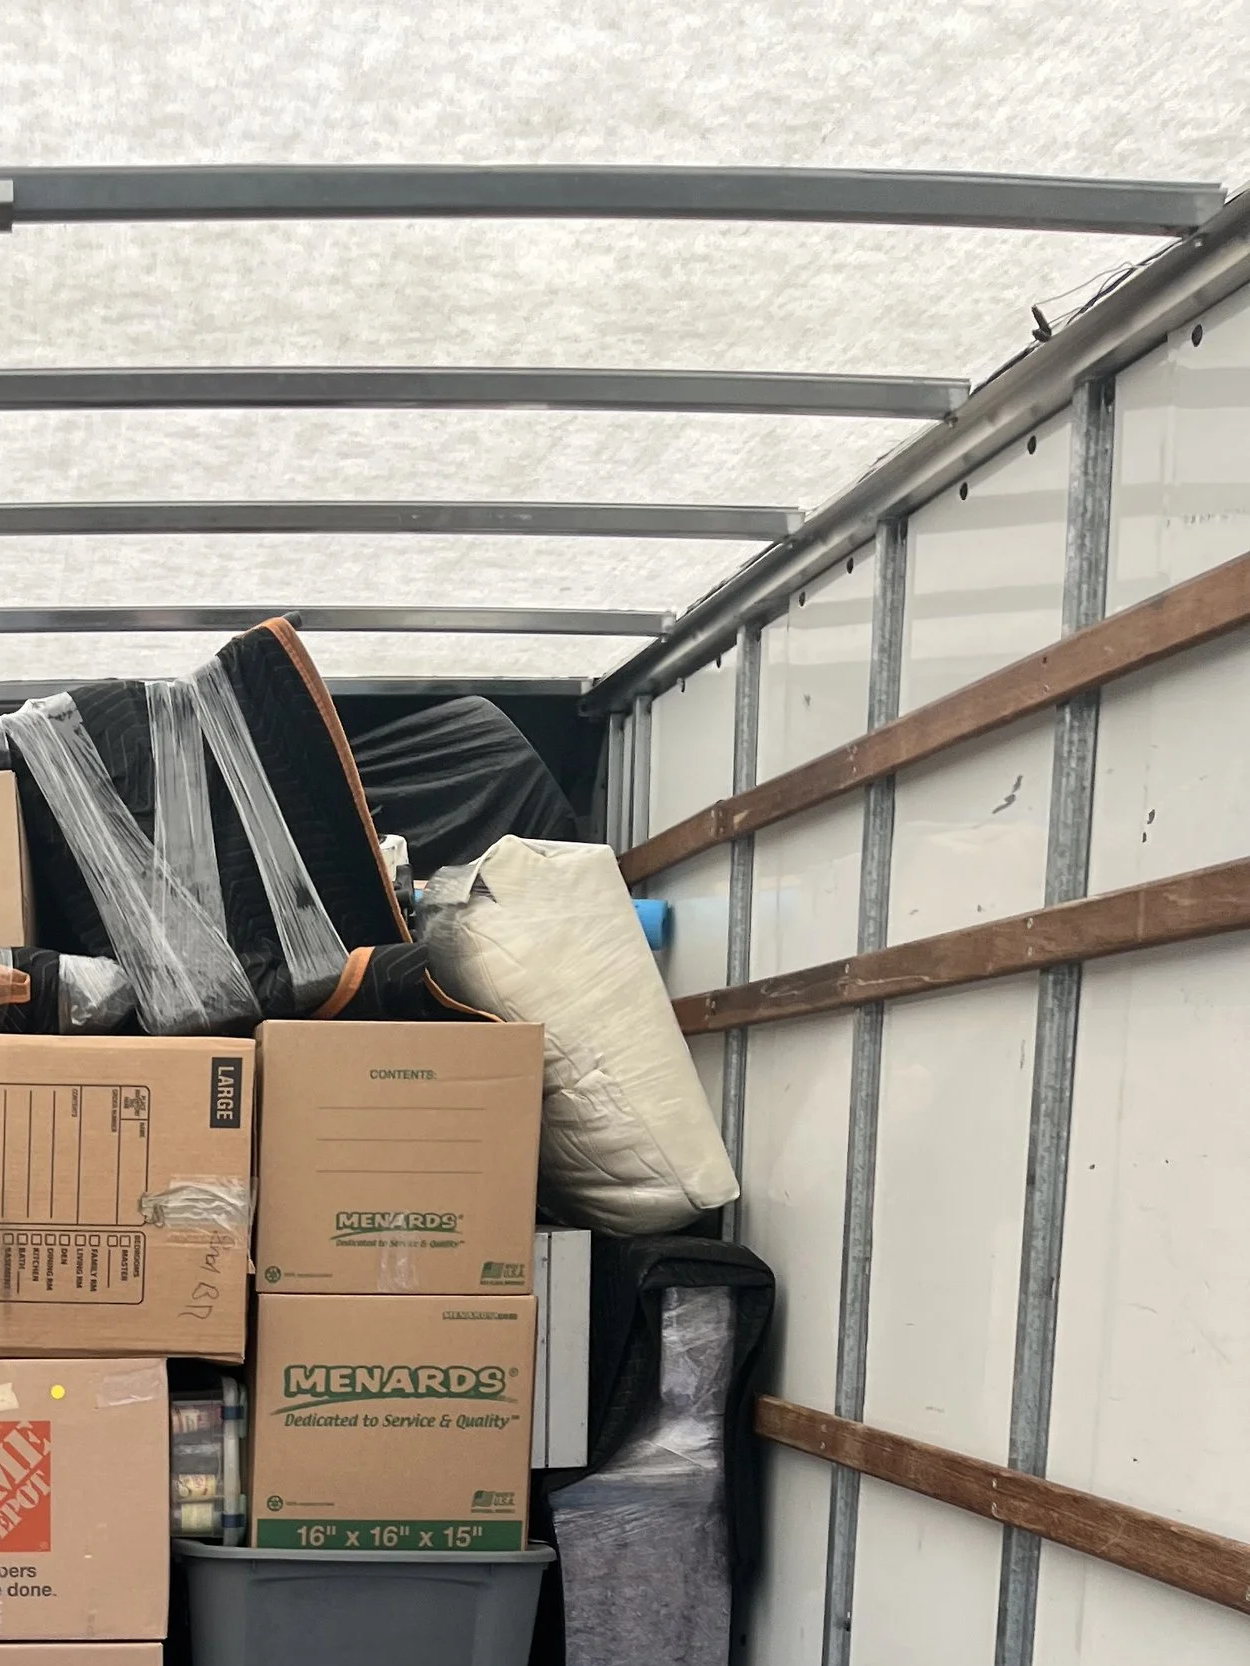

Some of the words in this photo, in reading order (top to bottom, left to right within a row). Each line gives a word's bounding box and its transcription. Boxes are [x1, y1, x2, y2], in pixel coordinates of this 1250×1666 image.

[216, 1066, 234, 1120] LARGE
[335, 1211, 457, 1231] MENARDS
[32, 1248, 40, 1282] KITCHEN
[46, 1248, 54, 1278] DINING
[76, 1248, 84, 1277] LIVING
[90, 1249, 98, 1280] FAMILY
[121, 1249, 129, 1281] MASTER
[133, 1235, 141, 1278] BEDROOMS
[46, 1279, 53, 1291] RM
[76, 1279, 82, 1289] RM
[90, 1281, 97, 1292] RM
[284, 1365, 506, 1398] MENARDS
[284, 1413, 358, 1427] Dedicated
[363, 1415, 379, 1427] to
[382, 1413, 435, 1428] Service
[439, 1413, 452, 1428] &
[456, 1413, 510, 1430] Quality
[297, 1525, 337, 1546] 16"
[345, 1530, 361, 1546] x
[369, 1525, 410, 1547] 16"
[418, 1531, 433, 1547] x
[444, 1526, 483, 1547] 15"
